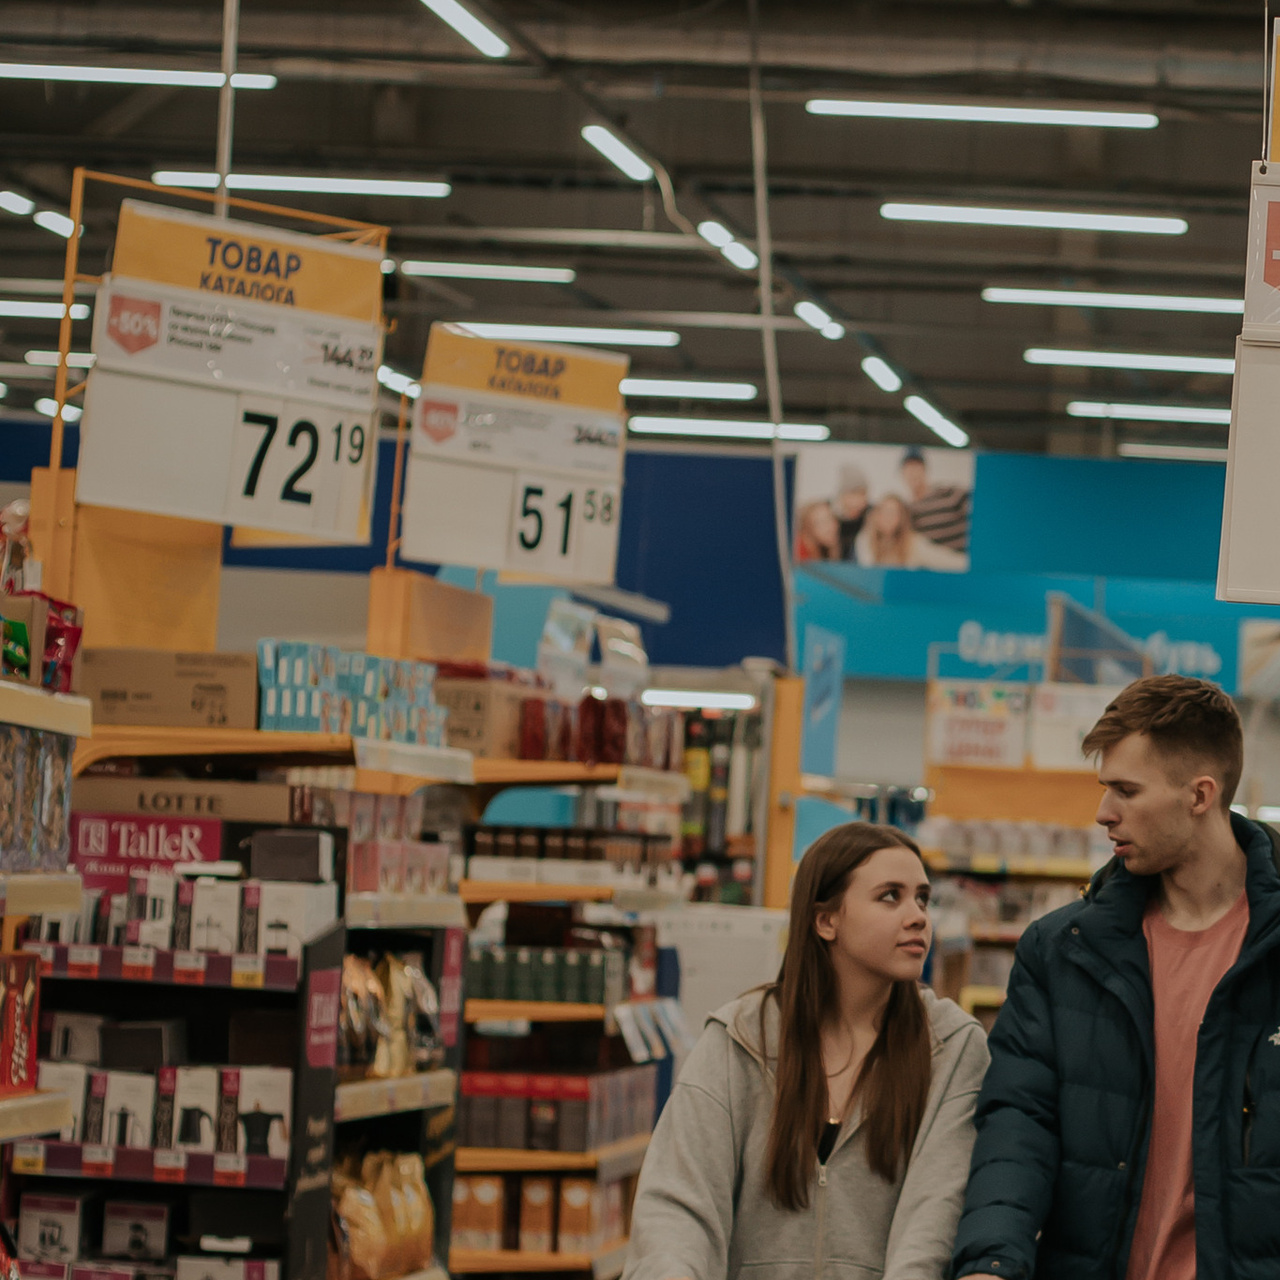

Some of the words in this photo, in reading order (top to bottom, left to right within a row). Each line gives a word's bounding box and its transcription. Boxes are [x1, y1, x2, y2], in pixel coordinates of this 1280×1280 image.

[206, 237, 302, 280] ТОВАР
[199, 272, 296, 306] КАТАЛОГА
[241, 410, 320, 506] 72
[332, 422, 366, 466] 19
[519, 485, 575, 556] 51
[138, 790, 222, 813] LOTTE
